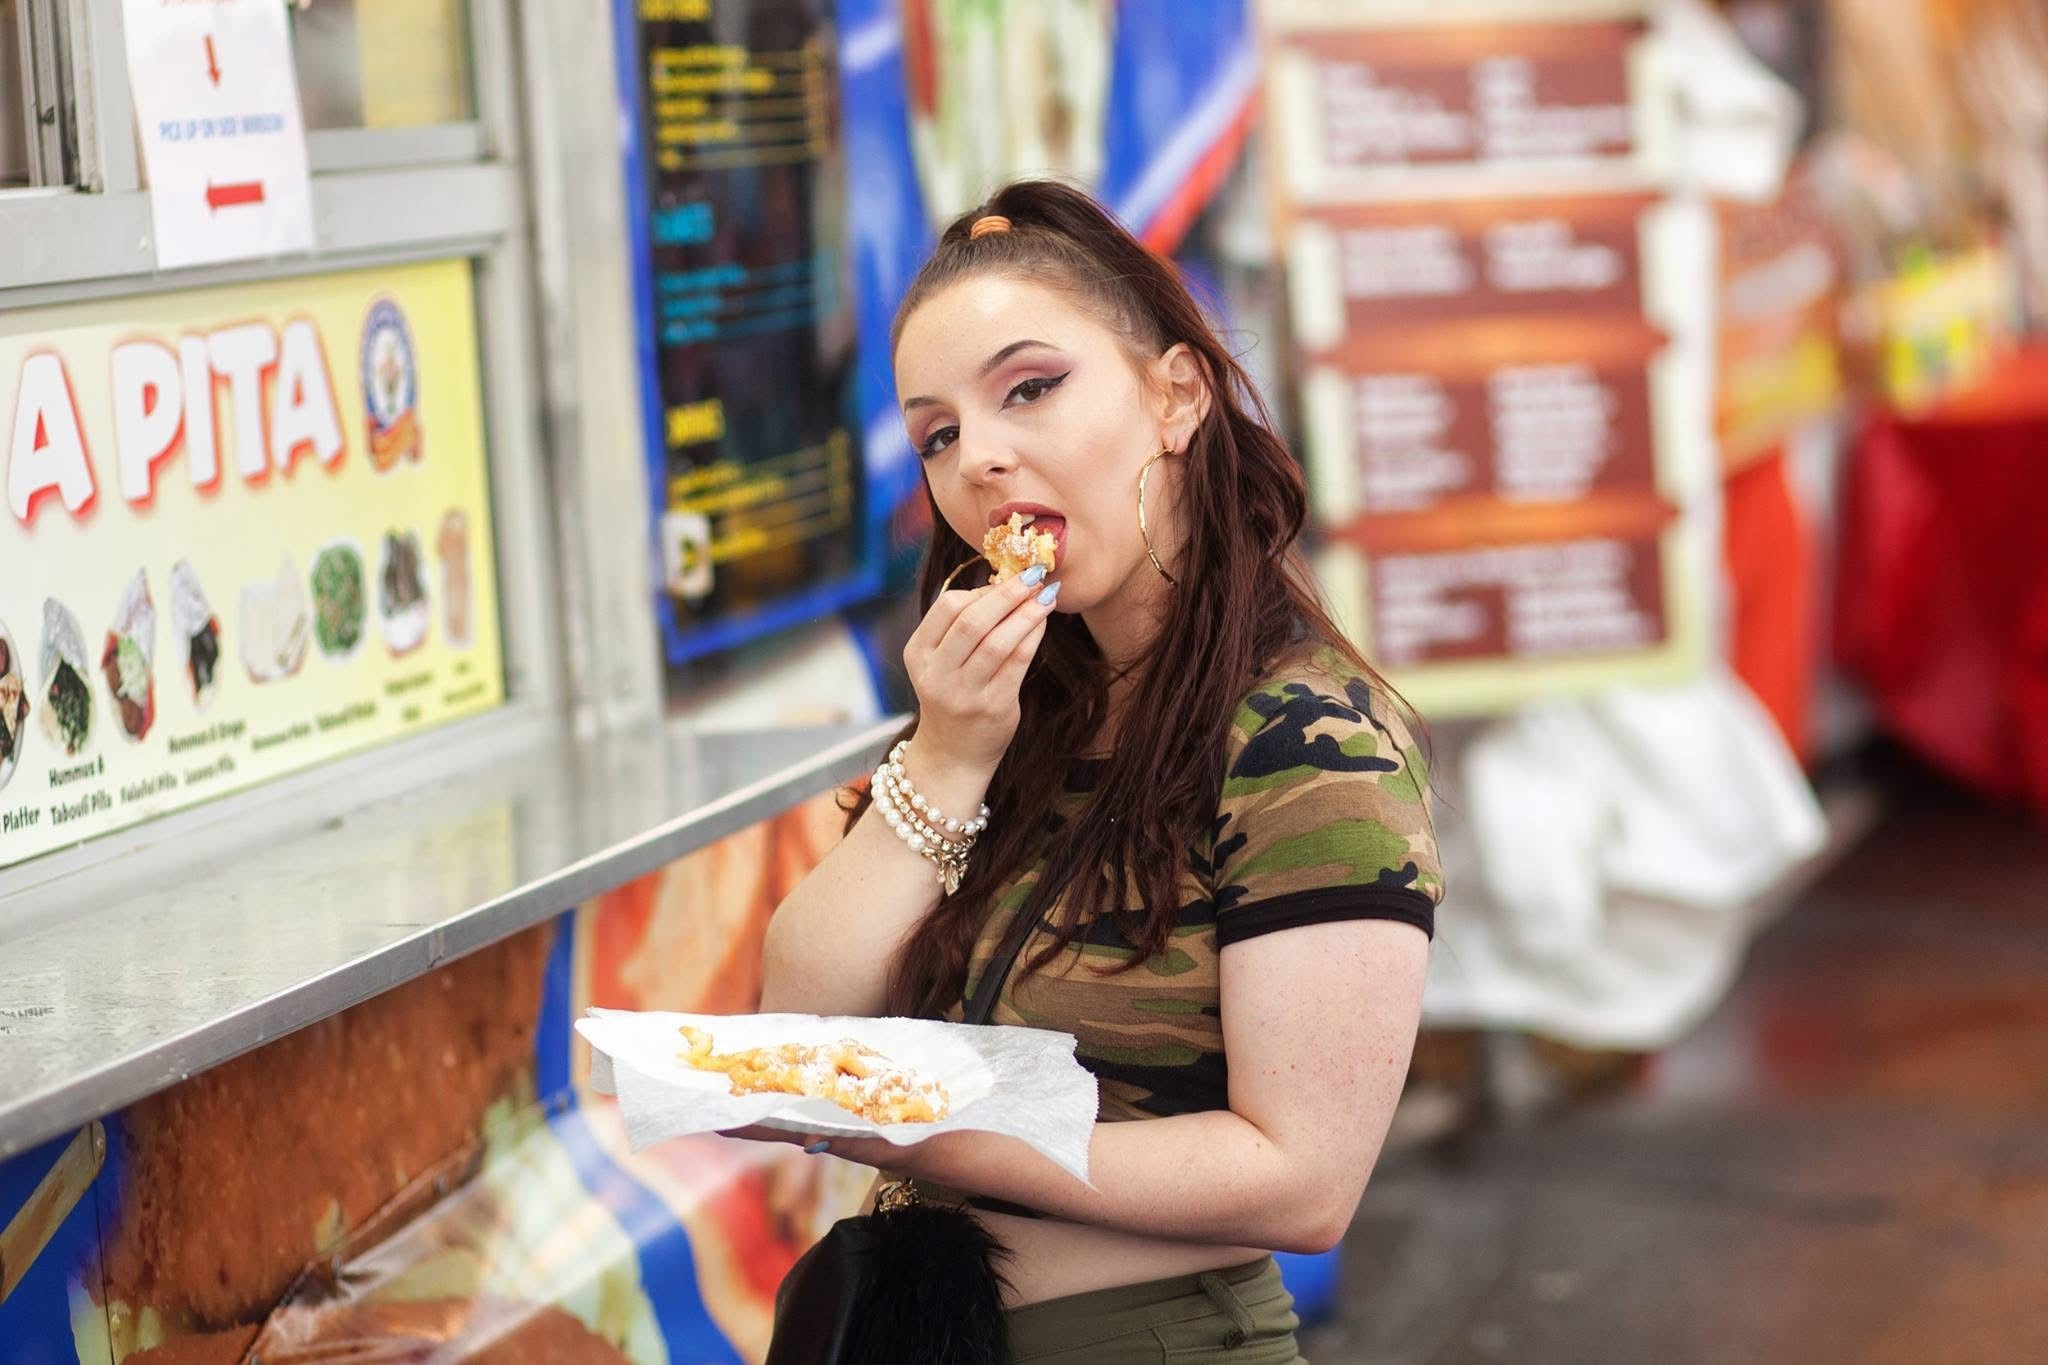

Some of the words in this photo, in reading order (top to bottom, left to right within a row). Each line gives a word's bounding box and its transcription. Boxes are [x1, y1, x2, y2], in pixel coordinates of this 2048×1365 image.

[7, 346, 98, 528] A
[110, 314, 348, 512] PITA
[49, 762, 95, 788] Hummus
[3, 806, 40, 833] Platter
